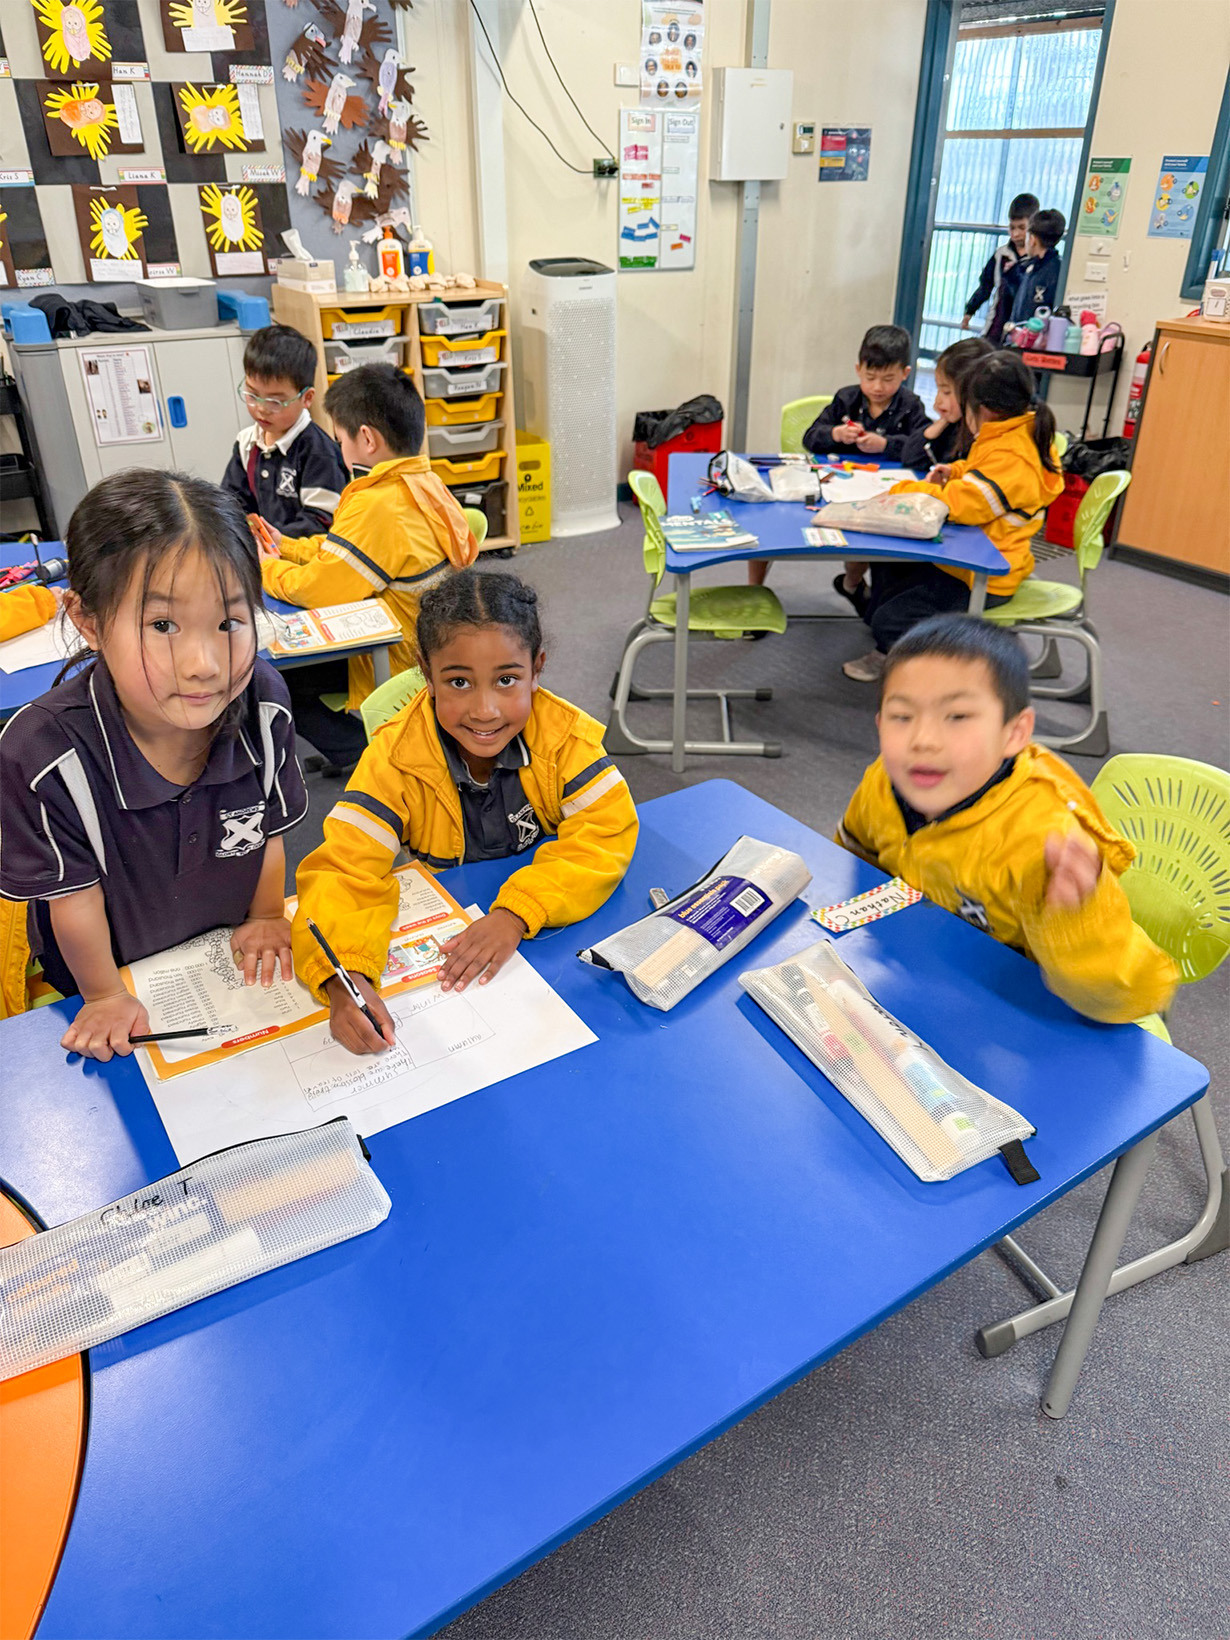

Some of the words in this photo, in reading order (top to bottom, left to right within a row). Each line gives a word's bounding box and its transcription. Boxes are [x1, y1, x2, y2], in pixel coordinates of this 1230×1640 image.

[113, 66, 128, 74] Han
[130, 67, 136, 75] K
[235, 70, 262, 78] Hannah
[631, 117, 644, 126] Sign
[669, 118, 681, 127] Sign
[682, 118, 694, 126] Out
[518, 481, 544, 492] Mixed
[849, 892, 905, 917] Nathan
[678, 907, 693, 919] blue
[835, 914, 850, 925] C
[408, 967, 436, 980] Seasons
[232, 1029, 269, 1044] Numbers
[101, 1195, 164, 1225] Chloe
[177, 1176, 193, 1196] T
